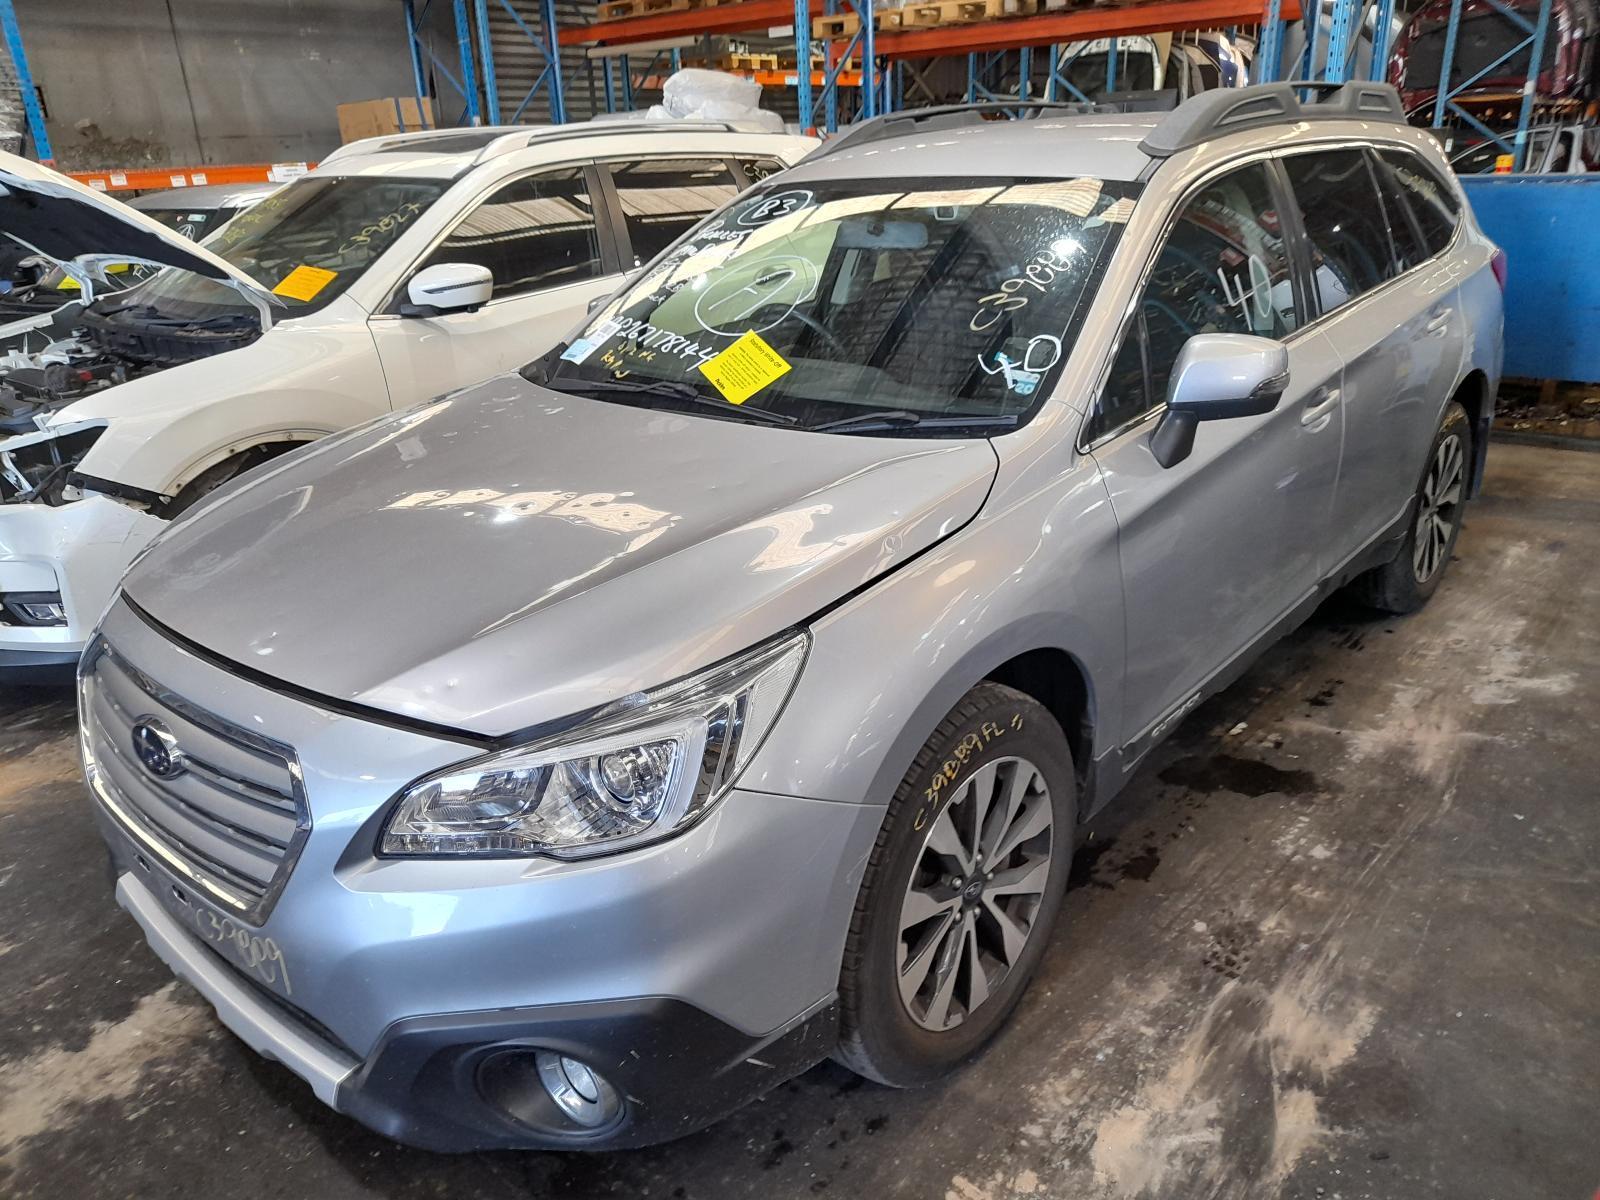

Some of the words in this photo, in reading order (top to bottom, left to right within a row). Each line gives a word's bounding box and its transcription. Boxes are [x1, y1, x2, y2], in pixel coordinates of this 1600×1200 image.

[751, 199, 798, 219] B3
[1217, 254, 1272, 332] 40
[977, 334, 1063, 390] 40
